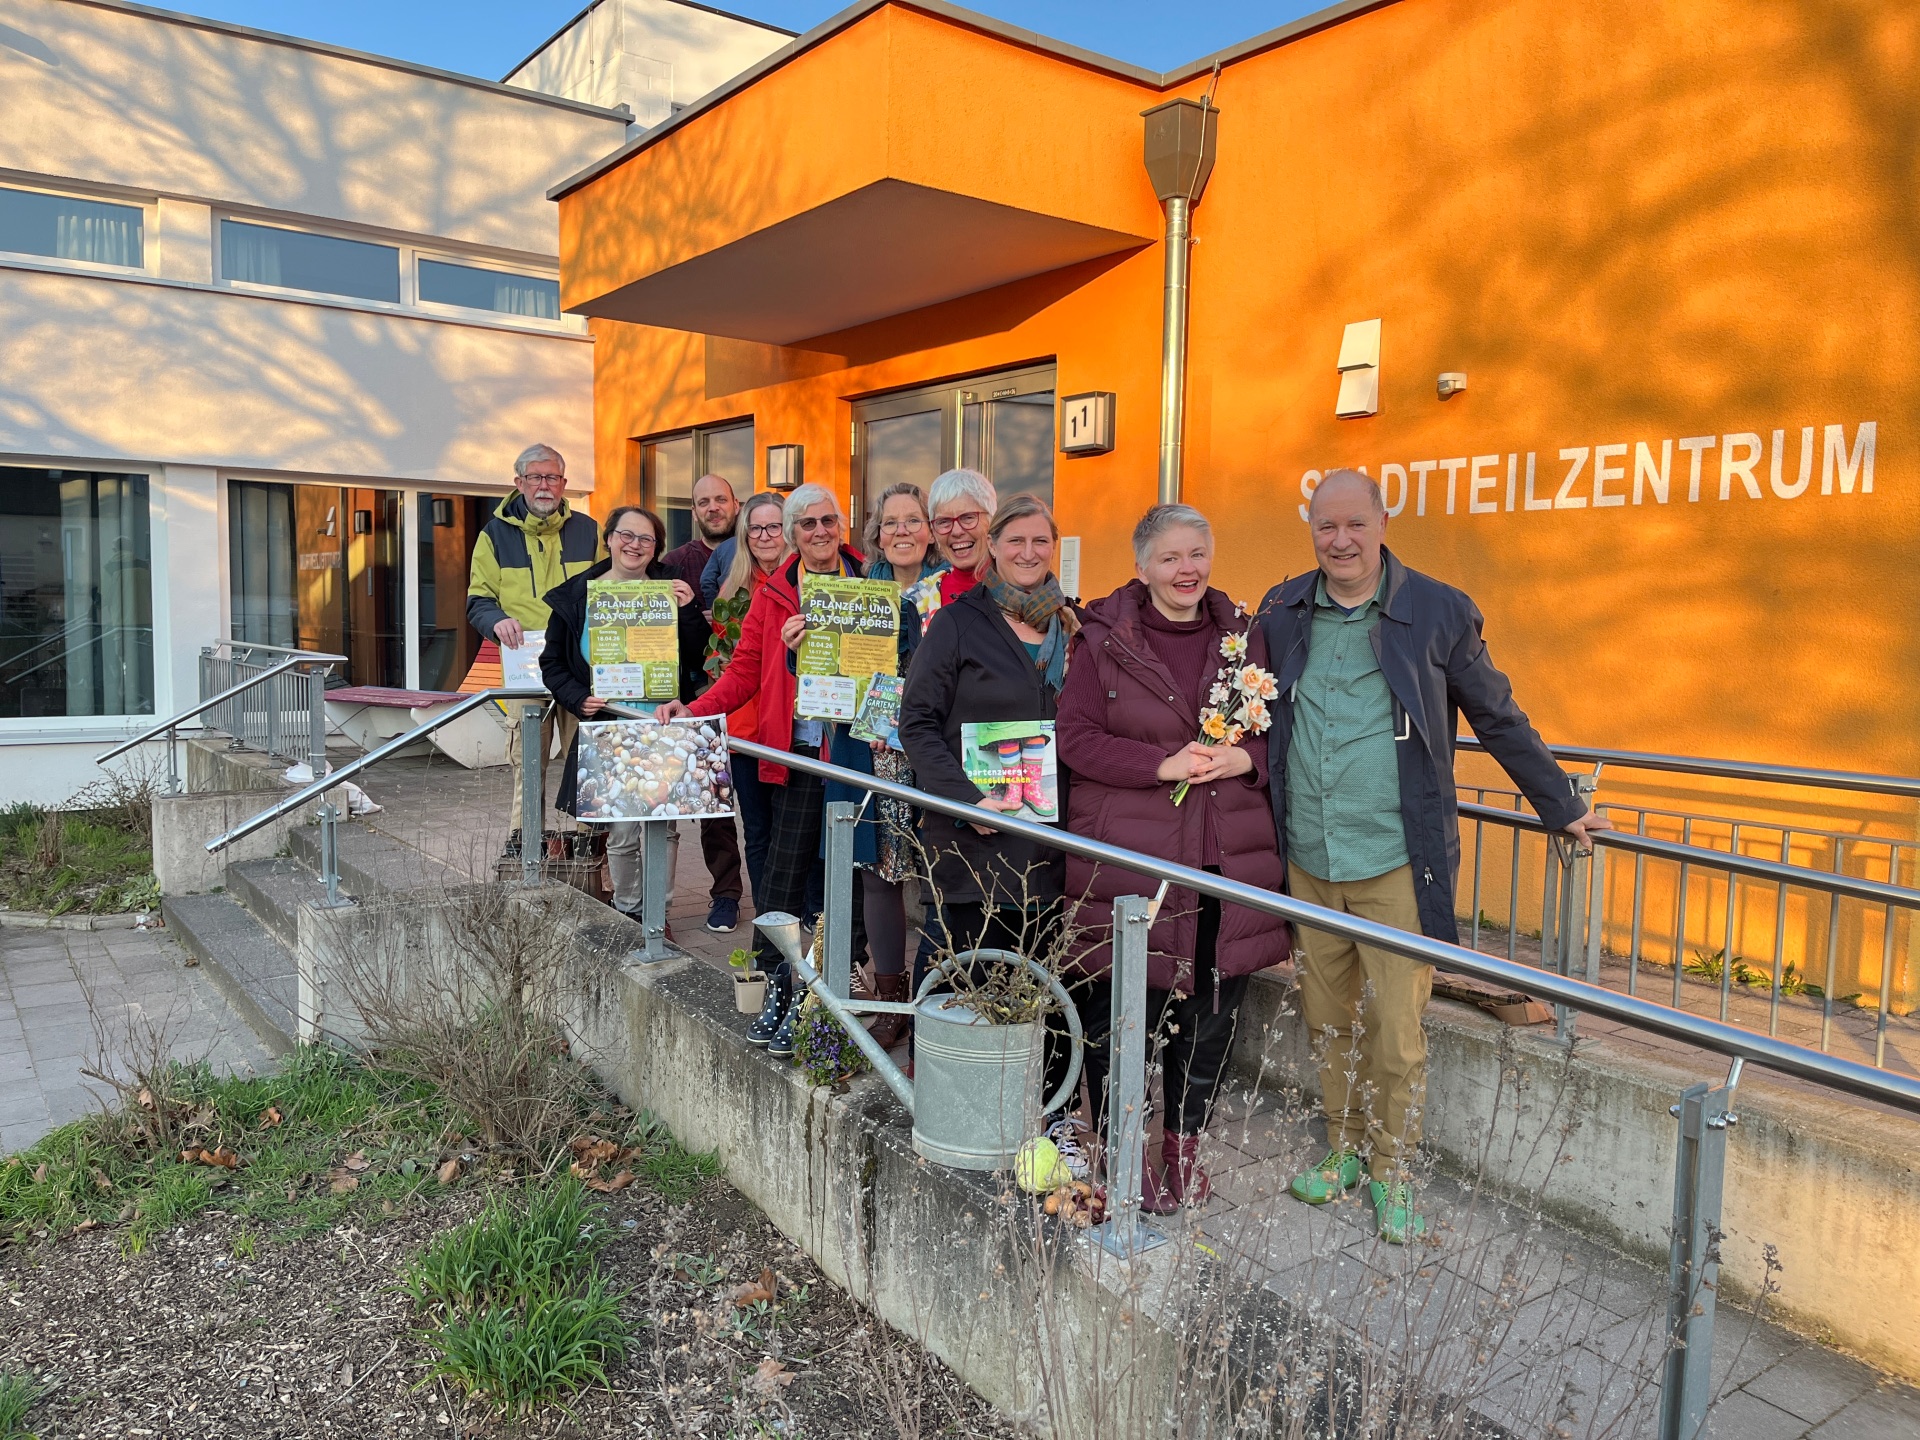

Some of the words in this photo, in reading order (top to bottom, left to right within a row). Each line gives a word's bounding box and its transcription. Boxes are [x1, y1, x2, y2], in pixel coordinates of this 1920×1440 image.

[1298, 421, 1877, 523] SDTTEILZENTRUM
[596, 600, 648, 608] PFLANZEN-
[649, 600, 670, 608] UND
[810, 599, 867, 612] PFLANZEN-
[869, 604, 892, 615] UND
[593, 610, 673, 620] SAATGUT-BÖRSE
[805, 613, 894, 629] SAATGUT-BÖRSE
[807, 641, 834, 649] 18.04.26
[969, 776, 1031, 784] änseblümchen
